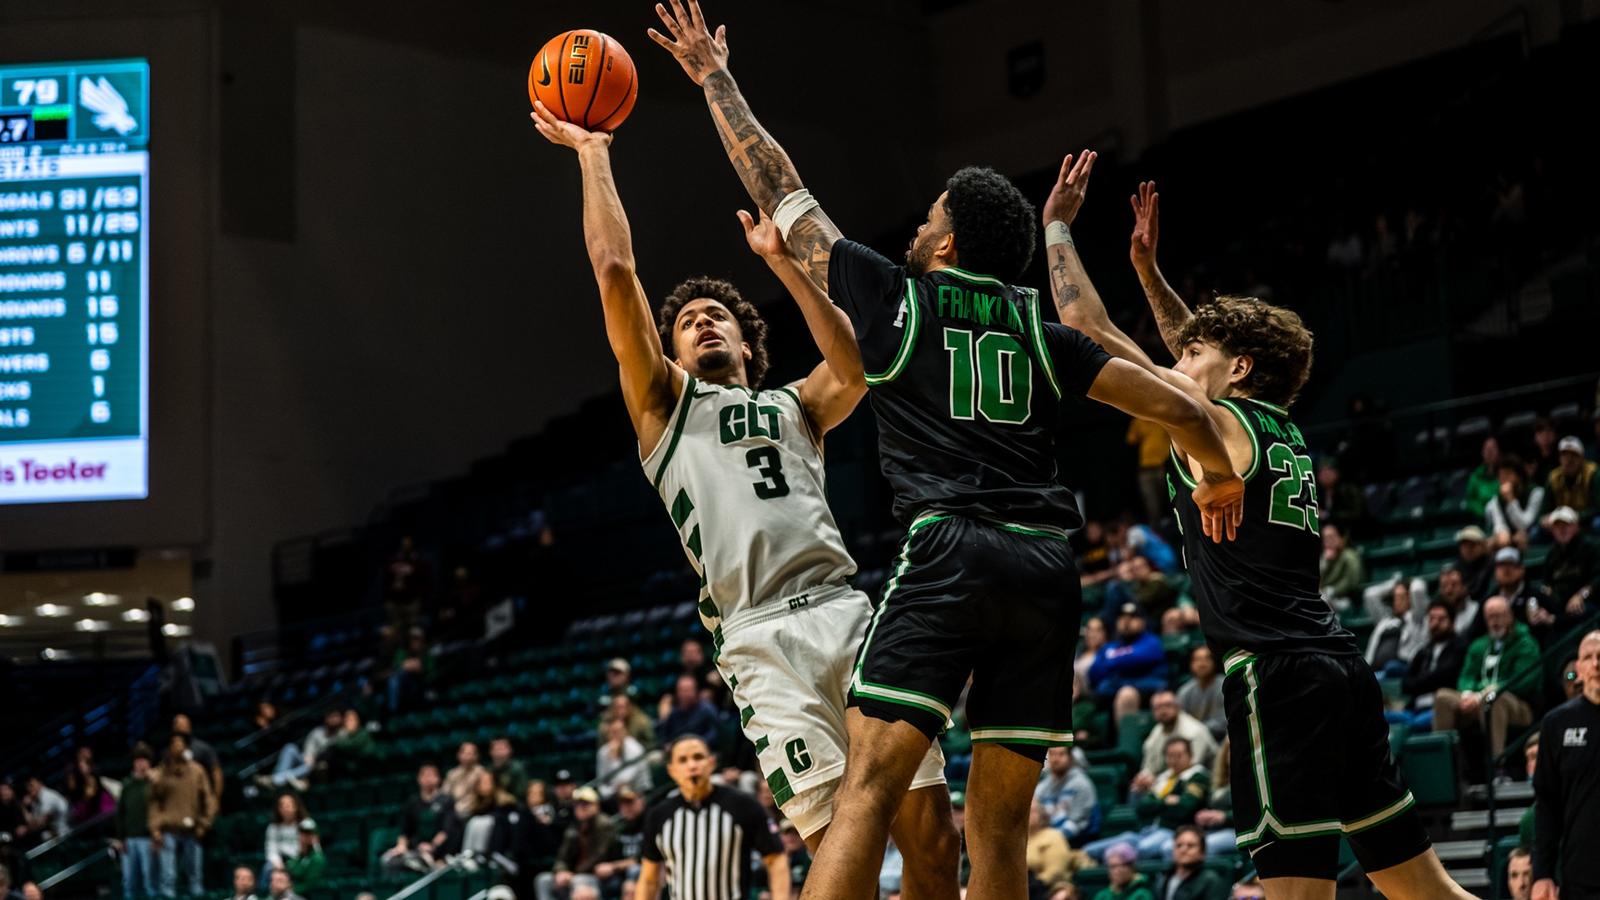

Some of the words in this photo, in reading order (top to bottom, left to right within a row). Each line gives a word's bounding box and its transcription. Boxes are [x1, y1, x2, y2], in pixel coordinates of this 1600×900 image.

[568, 35, 589, 84] ELITE
[13, 78, 59, 106] 79
[86, 270, 111, 293] 11
[92, 375, 105, 398] 1
[943, 327, 1032, 425] 10
[719, 401, 783, 445] CLT
[745, 446, 790, 500] 3
[1266, 442, 1320, 537] 23
[788, 593, 810, 610] CLT
